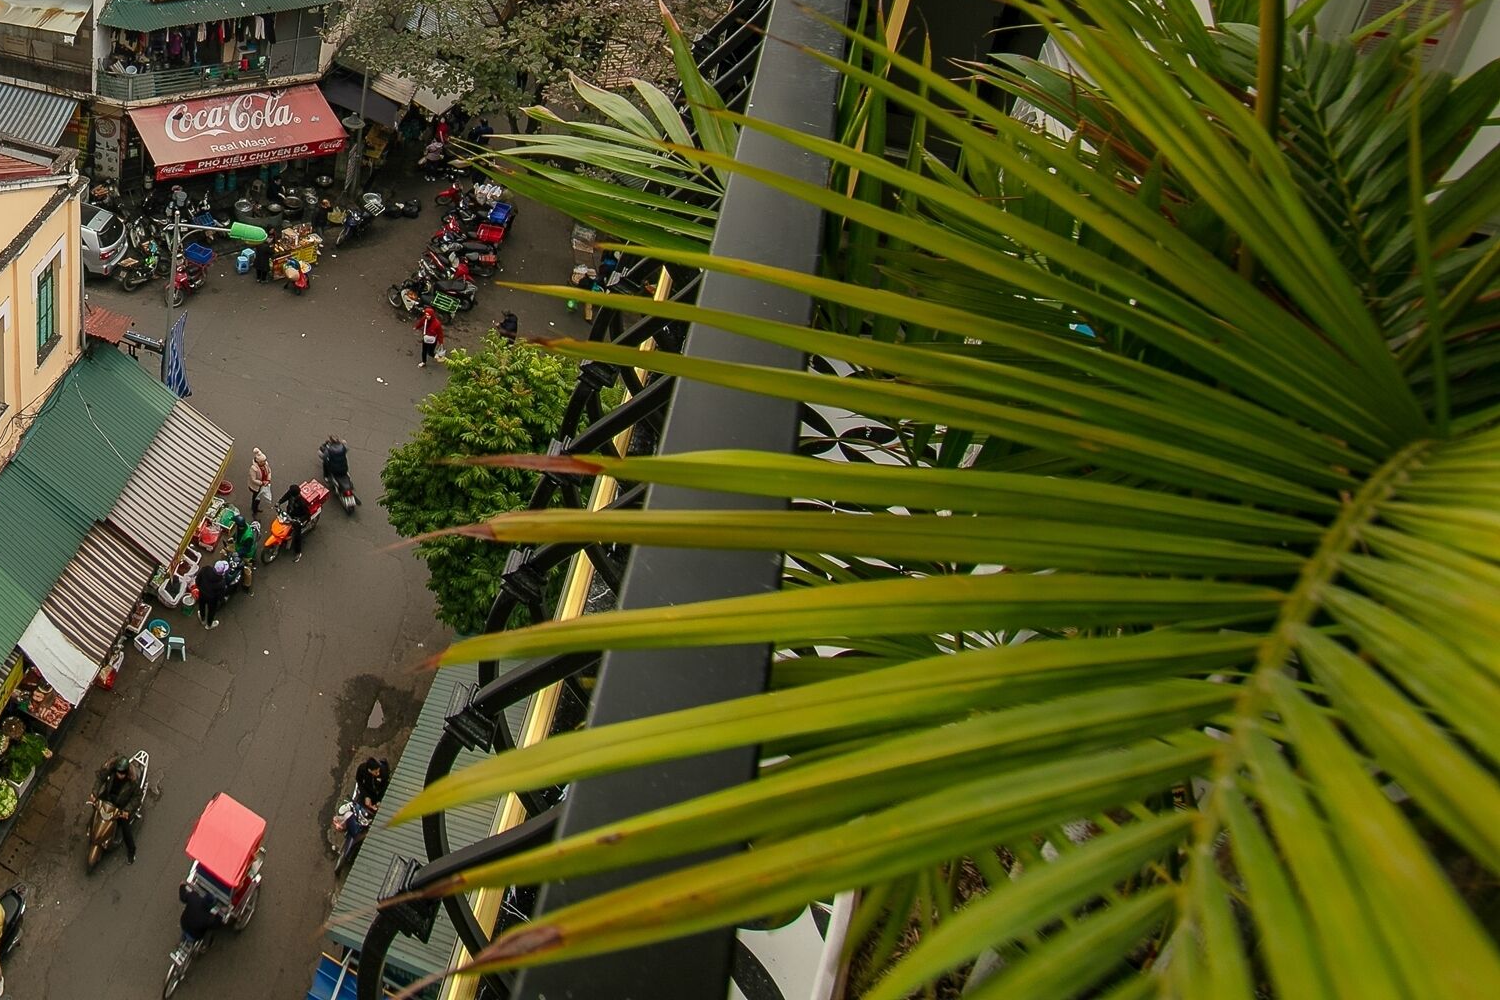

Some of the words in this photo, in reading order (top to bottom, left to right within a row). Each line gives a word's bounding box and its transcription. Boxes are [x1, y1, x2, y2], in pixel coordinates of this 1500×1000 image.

[164, 88, 294, 143] Coca-Cola
[209, 142, 238, 153] Real
[239, 136, 276, 149] Magic
